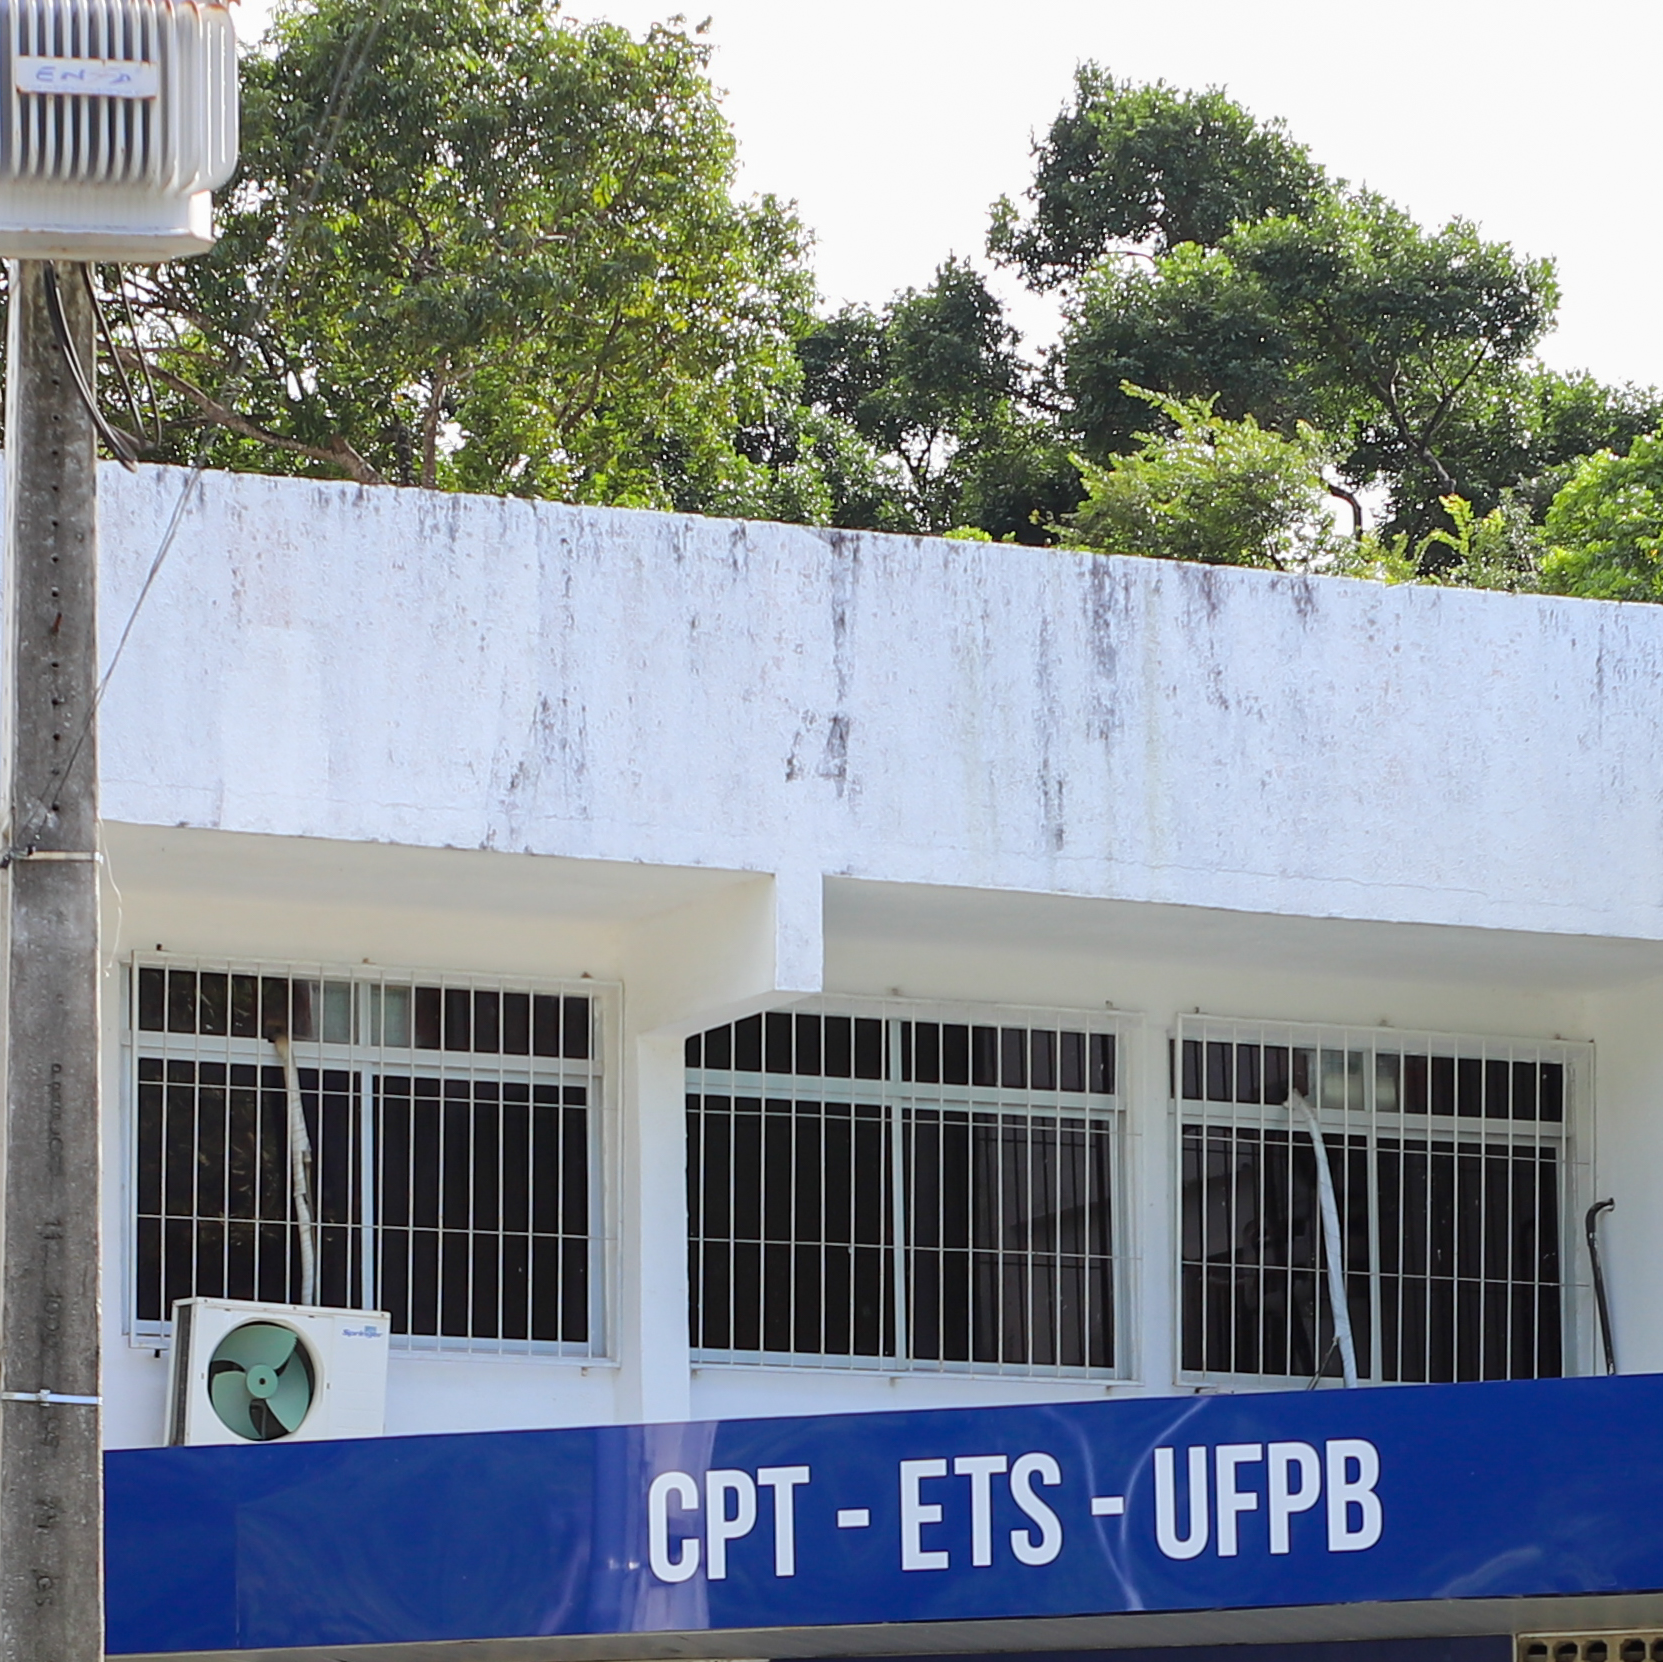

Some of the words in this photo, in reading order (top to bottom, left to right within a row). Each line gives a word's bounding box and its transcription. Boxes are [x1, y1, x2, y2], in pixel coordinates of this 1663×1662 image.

[648, 1465, 811, 1584] CPT
[837, 1507, 872, 1529] -
[900, 1451, 1064, 1572] ETS
[1090, 1495, 1125, 1516] -
[1154, 1438, 1384, 1561] UFPB
